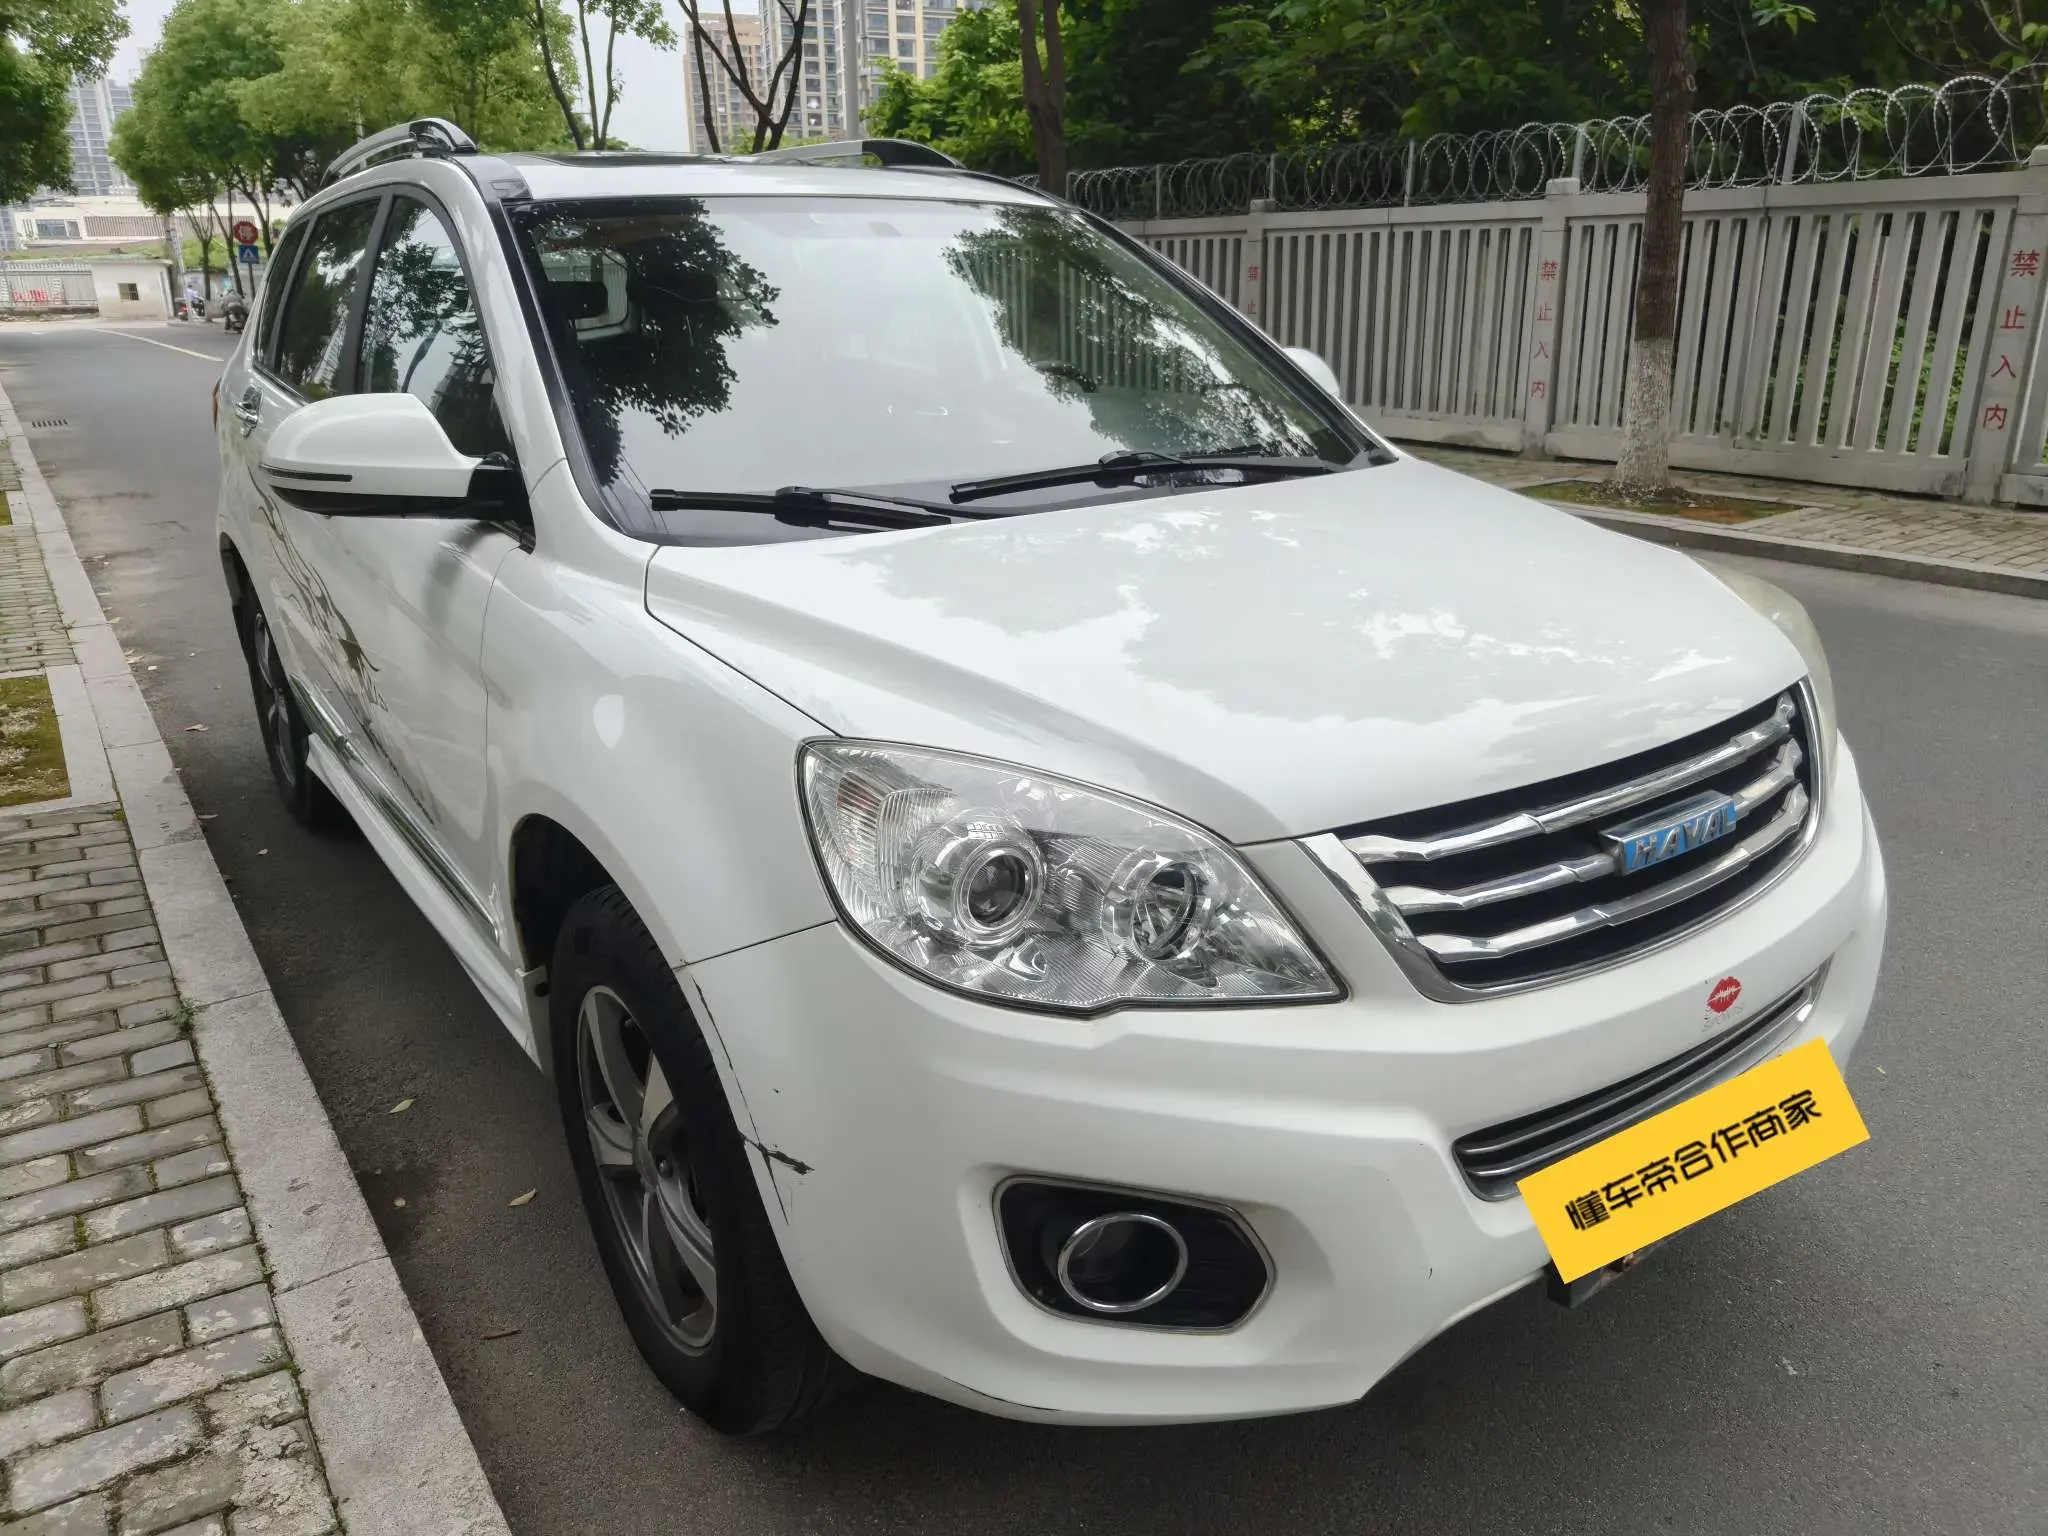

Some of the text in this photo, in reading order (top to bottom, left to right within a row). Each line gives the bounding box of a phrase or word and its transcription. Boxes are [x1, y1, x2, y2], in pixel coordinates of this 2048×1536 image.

[1530, 261, 1559, 401] 禁止入内
[1981, 249, 2041, 432] 禁止入内
[1631, 805, 1737, 868] HAVAL
